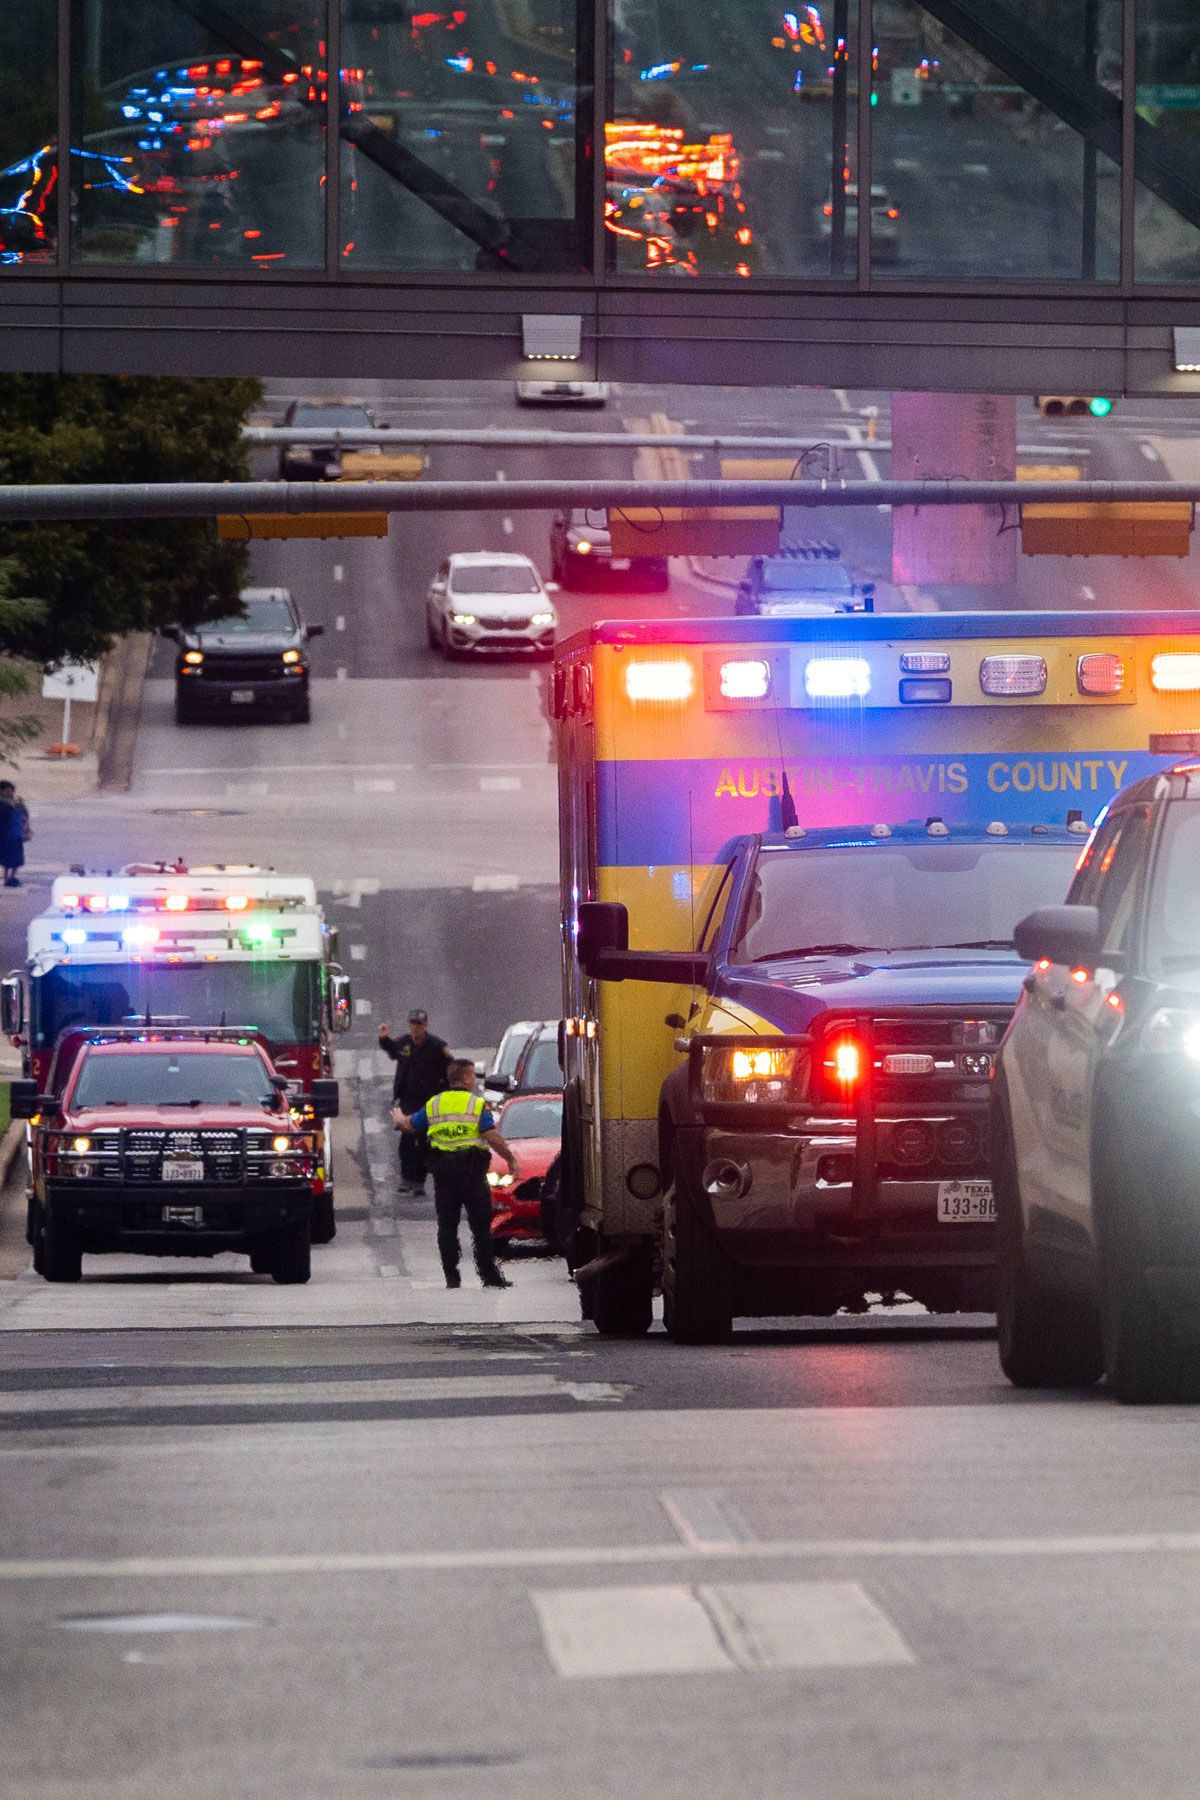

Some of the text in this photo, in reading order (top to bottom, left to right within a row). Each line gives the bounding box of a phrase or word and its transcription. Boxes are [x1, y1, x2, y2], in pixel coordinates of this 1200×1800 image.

[714, 760, 1128, 799] AUSTIN-TRAVIS COUNTY
[964, 1185, 994, 1194] TEXA
